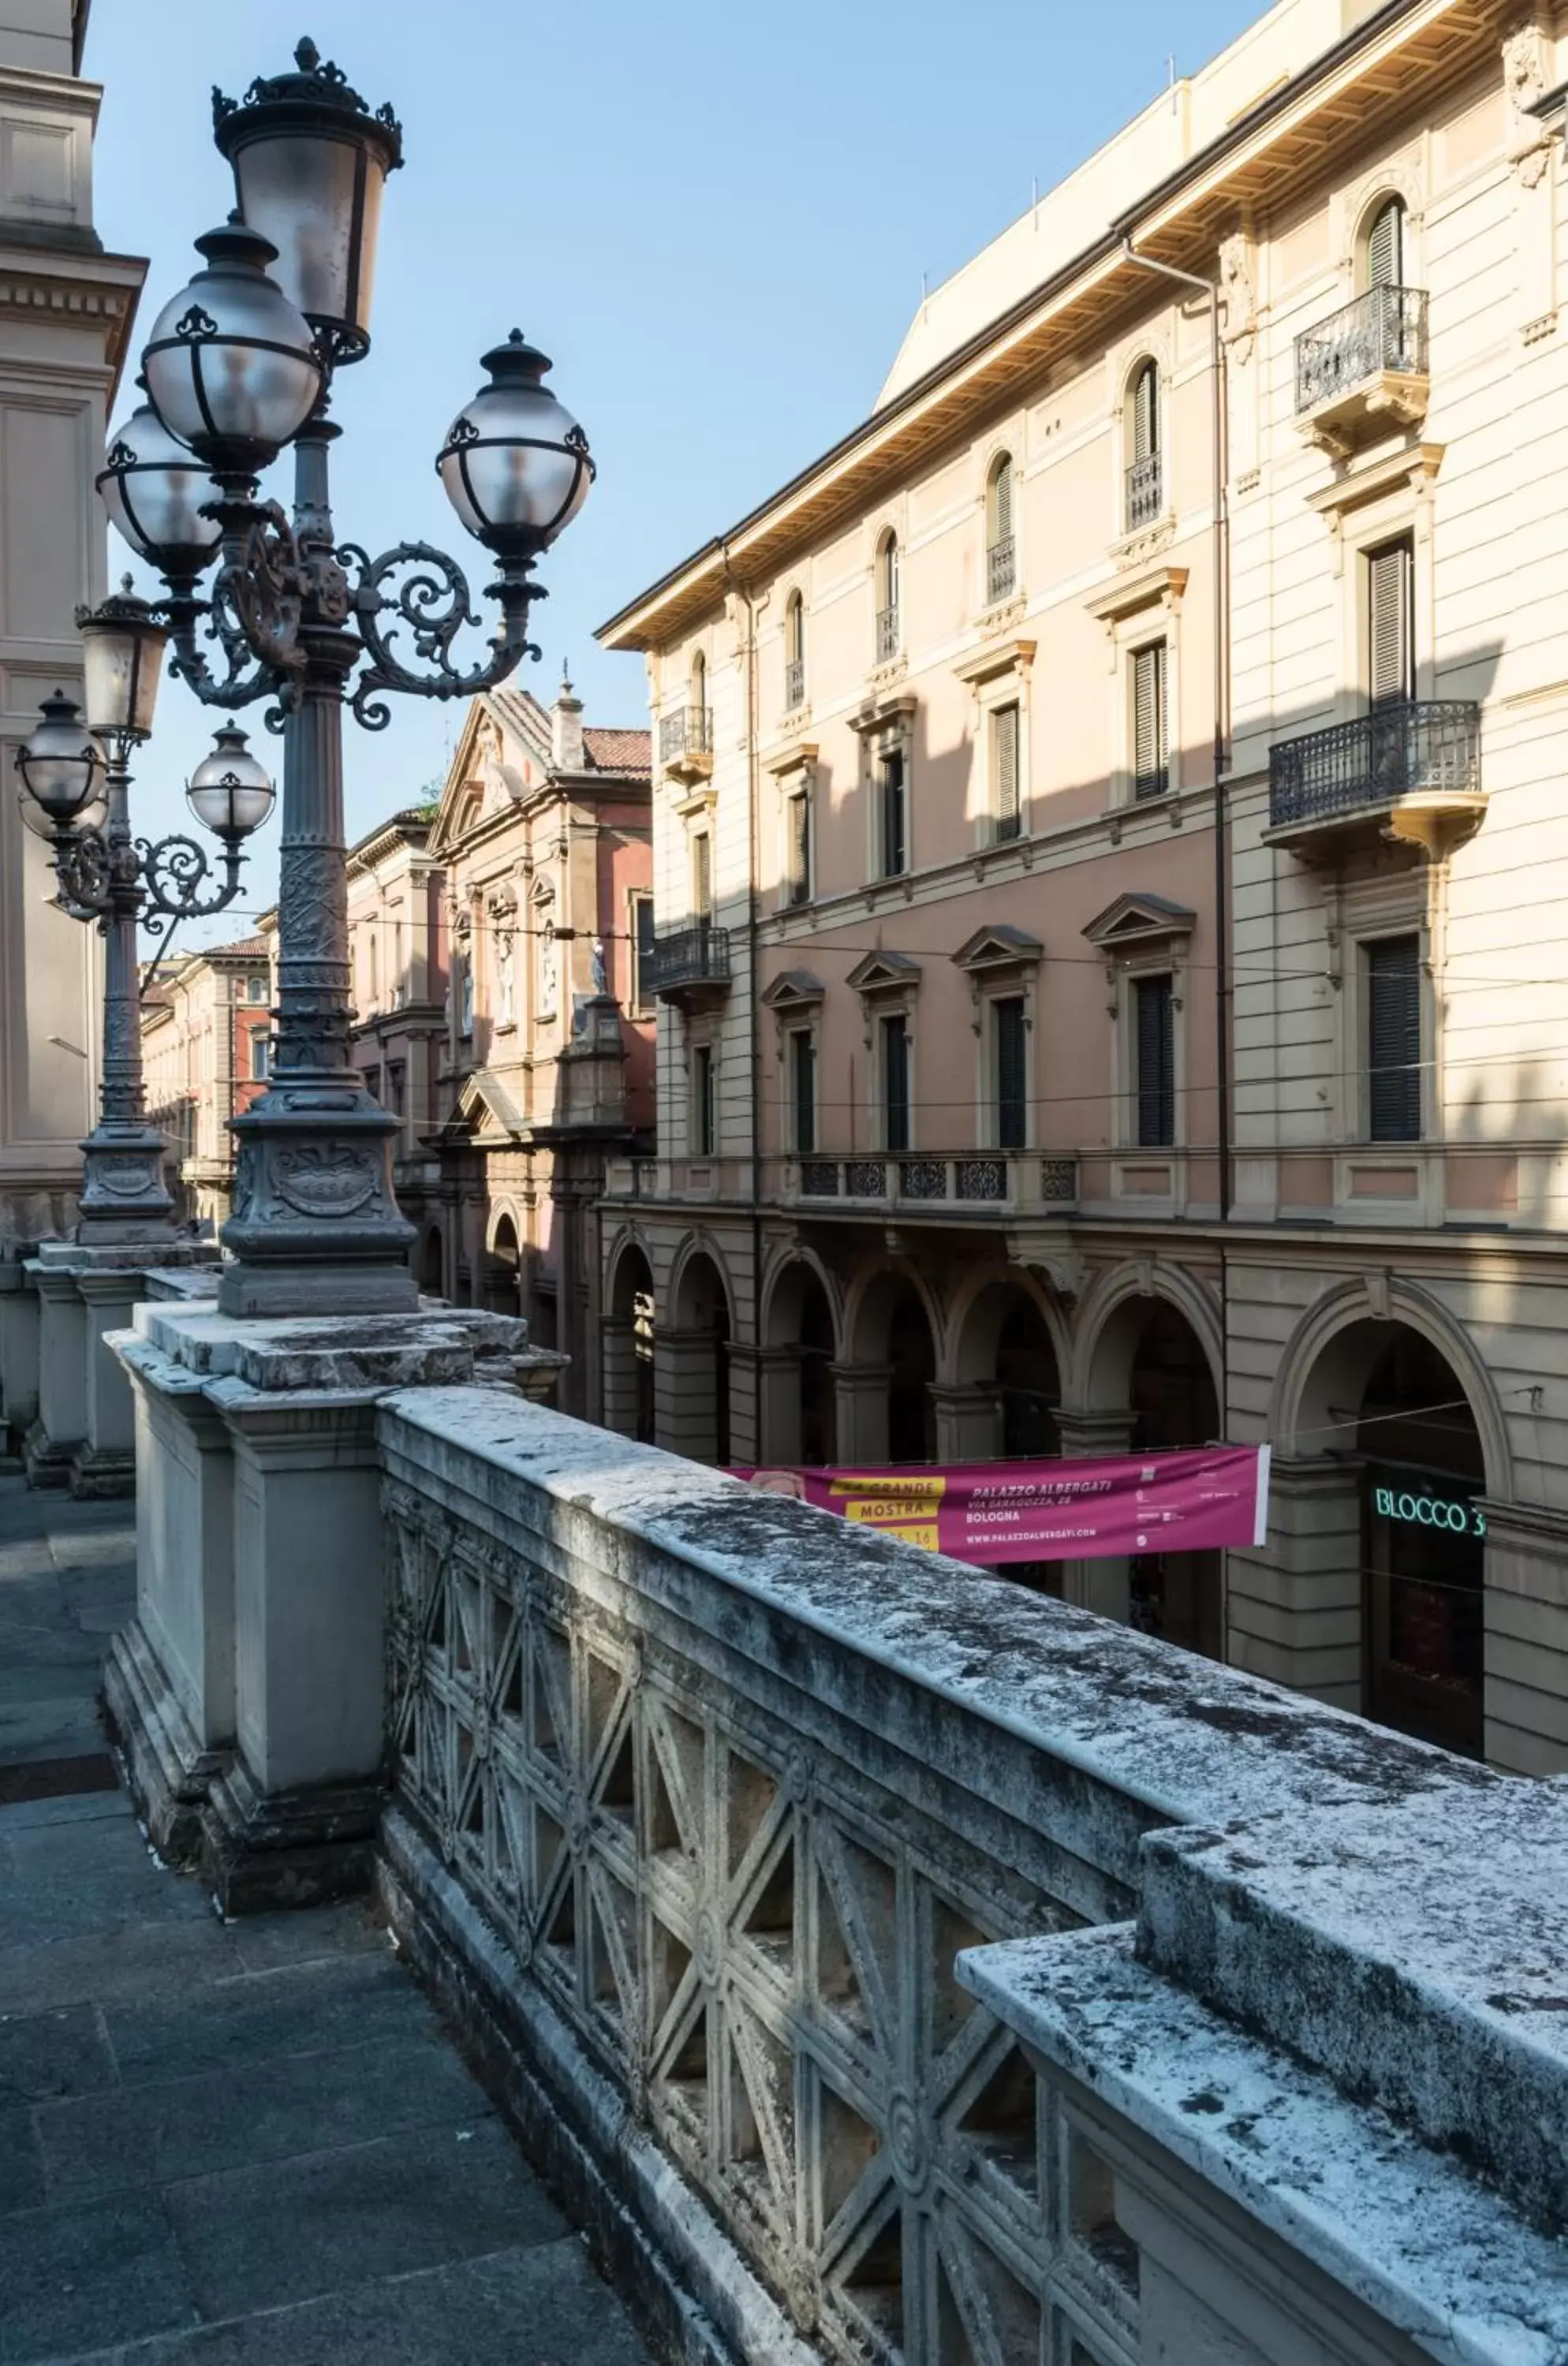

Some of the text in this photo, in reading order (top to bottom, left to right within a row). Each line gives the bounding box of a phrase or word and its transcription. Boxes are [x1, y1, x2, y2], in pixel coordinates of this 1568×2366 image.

[868, 1481, 934, 1495] GRANDE
[973, 1480, 1111, 1498] PALAZZO ALBERGATI
[860, 1501, 924, 1518] MOSTRA
[966, 1511, 1020, 1523] BOLOGNA
[1376, 1487, 1466, 1532] BLOCCO
[966, 1529, 1096, 1544] WWW.PALAZZOALBERGATI.COM
